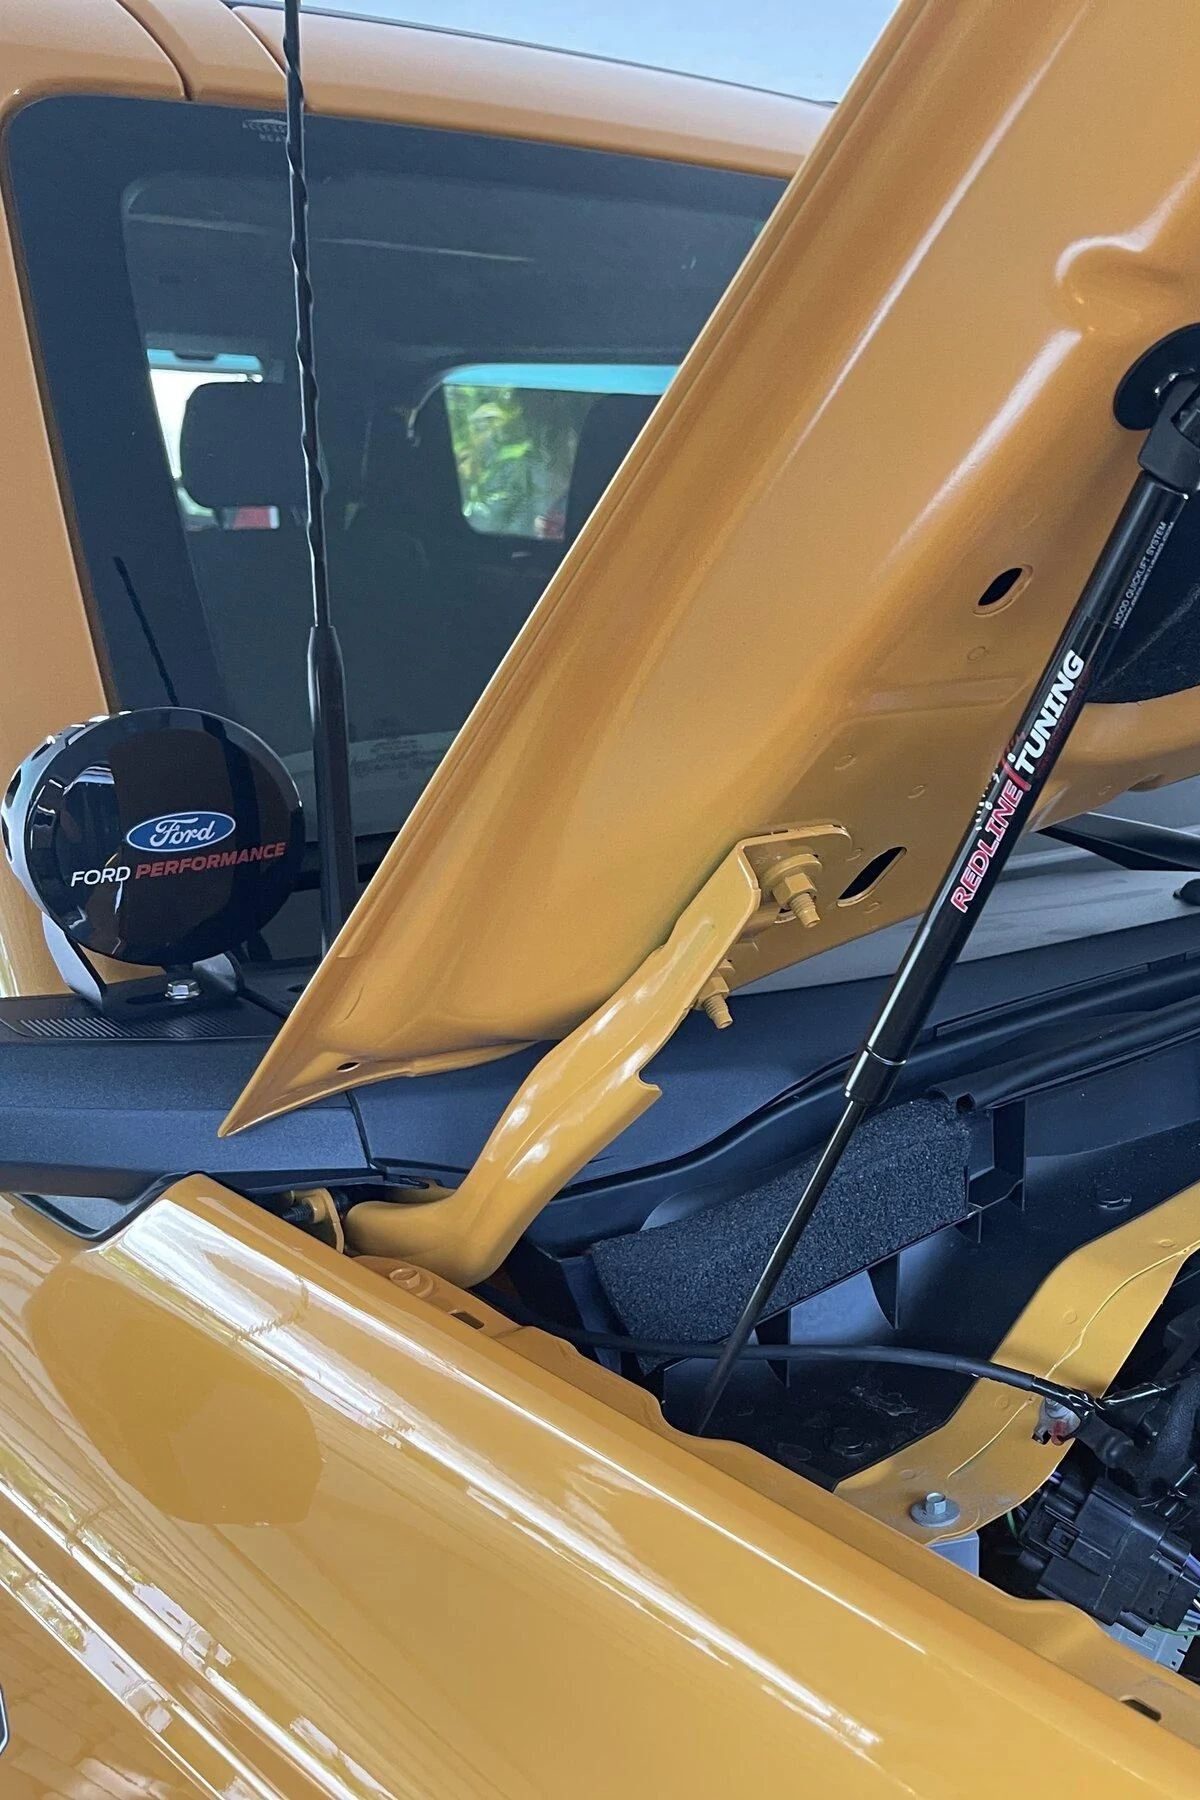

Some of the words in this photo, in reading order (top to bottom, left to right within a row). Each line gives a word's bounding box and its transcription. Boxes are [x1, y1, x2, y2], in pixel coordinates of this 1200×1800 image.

[1113, 599, 1130, 625] HOOD
[1125, 555, 1150, 599] QUICKLIFT
[1145, 521, 1167, 556] SYSTEM
[951, 778, 1024, 914] REDLINE
[1014, 650, 1084, 775] TUNING
[70, 866, 131, 887] FORD
[135, 842, 287, 879] PERFORMANCE
[150, 817, 216, 847] Ford
